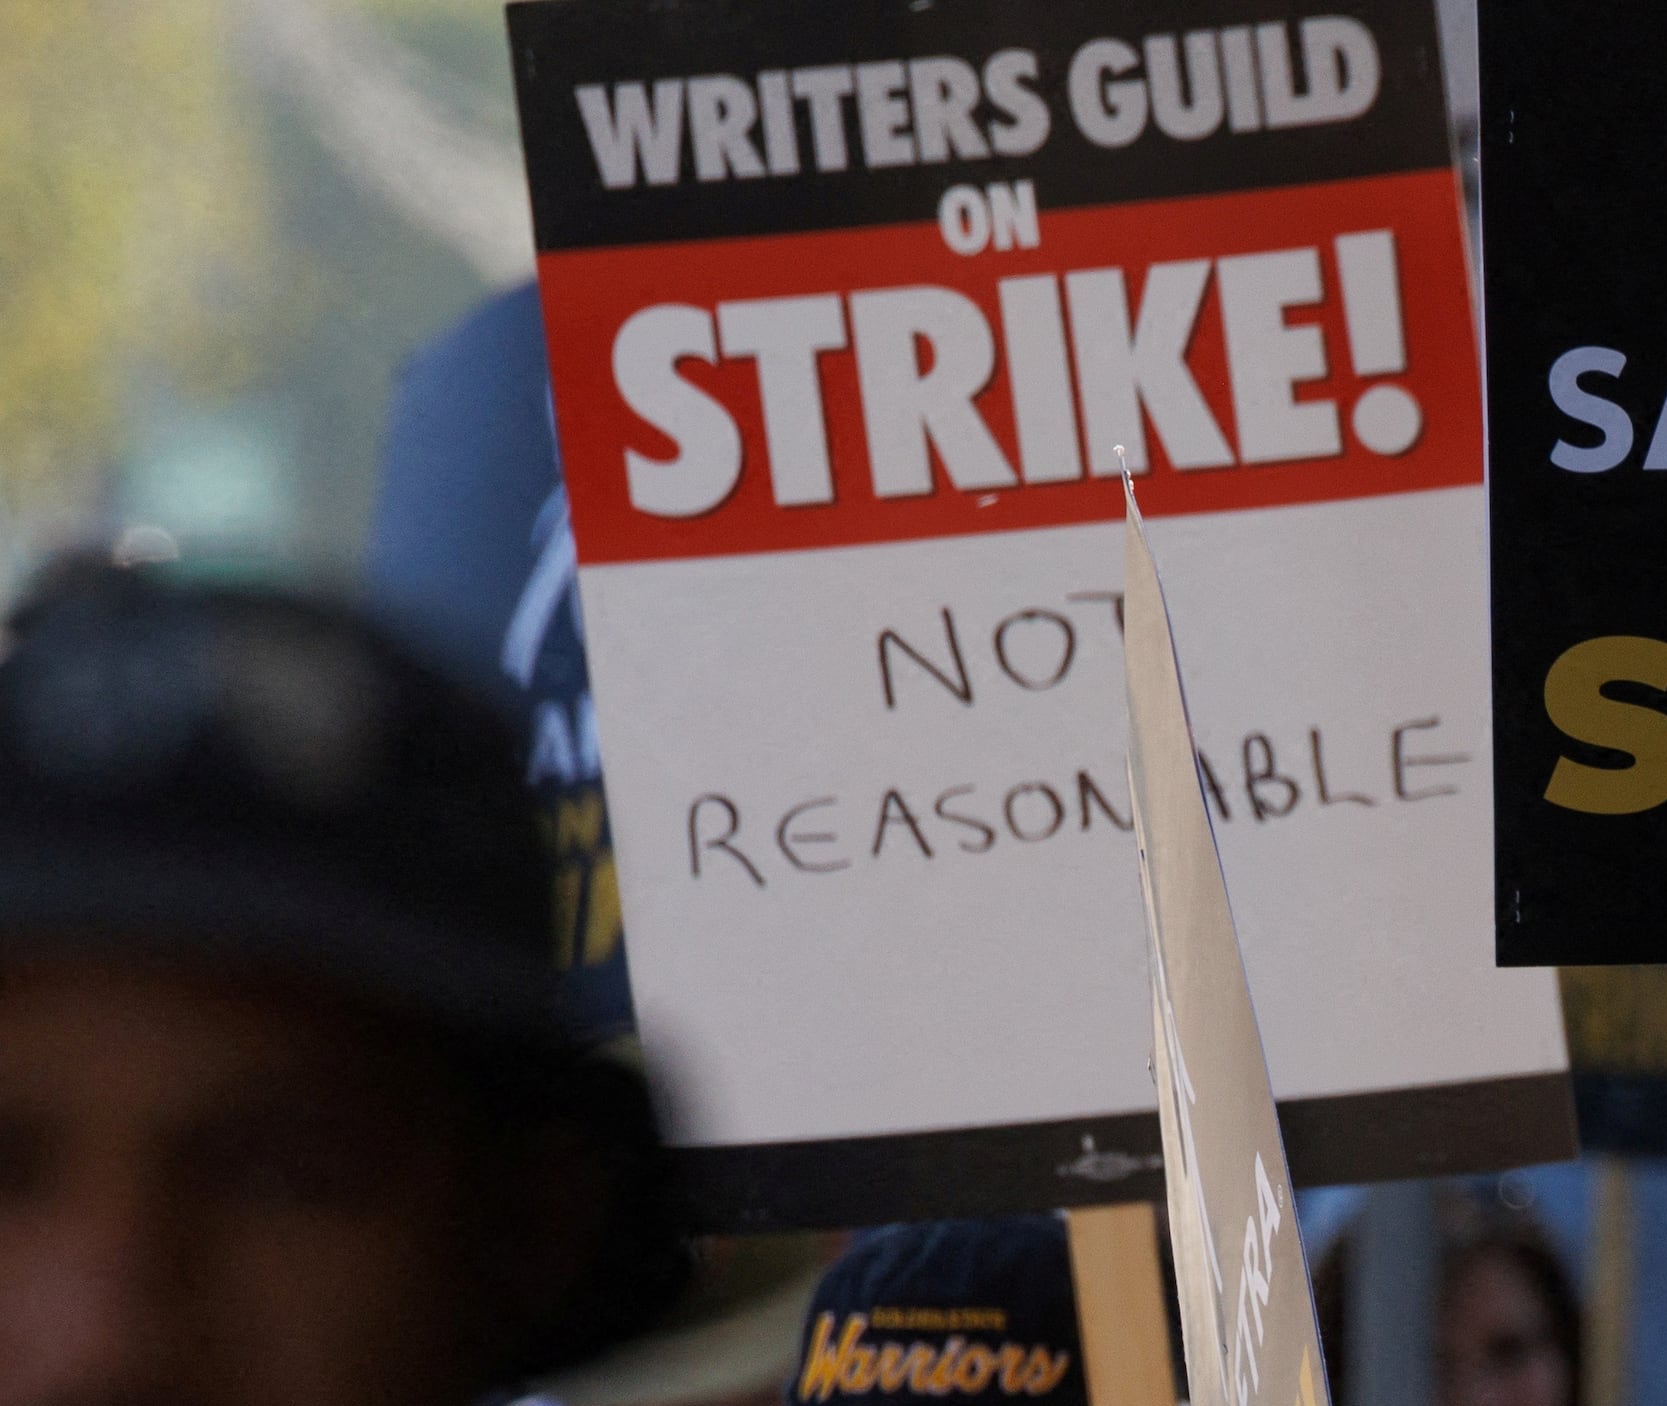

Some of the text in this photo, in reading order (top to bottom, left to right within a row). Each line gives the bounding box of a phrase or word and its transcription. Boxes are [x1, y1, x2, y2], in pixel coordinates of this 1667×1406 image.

[576, 17, 1382, 190] WRITERS GUILD
[938, 181, 1040, 256] ON
[612, 228, 1424, 519] STRIKE!
[799, 1310, 1069, 1403] Warriors
